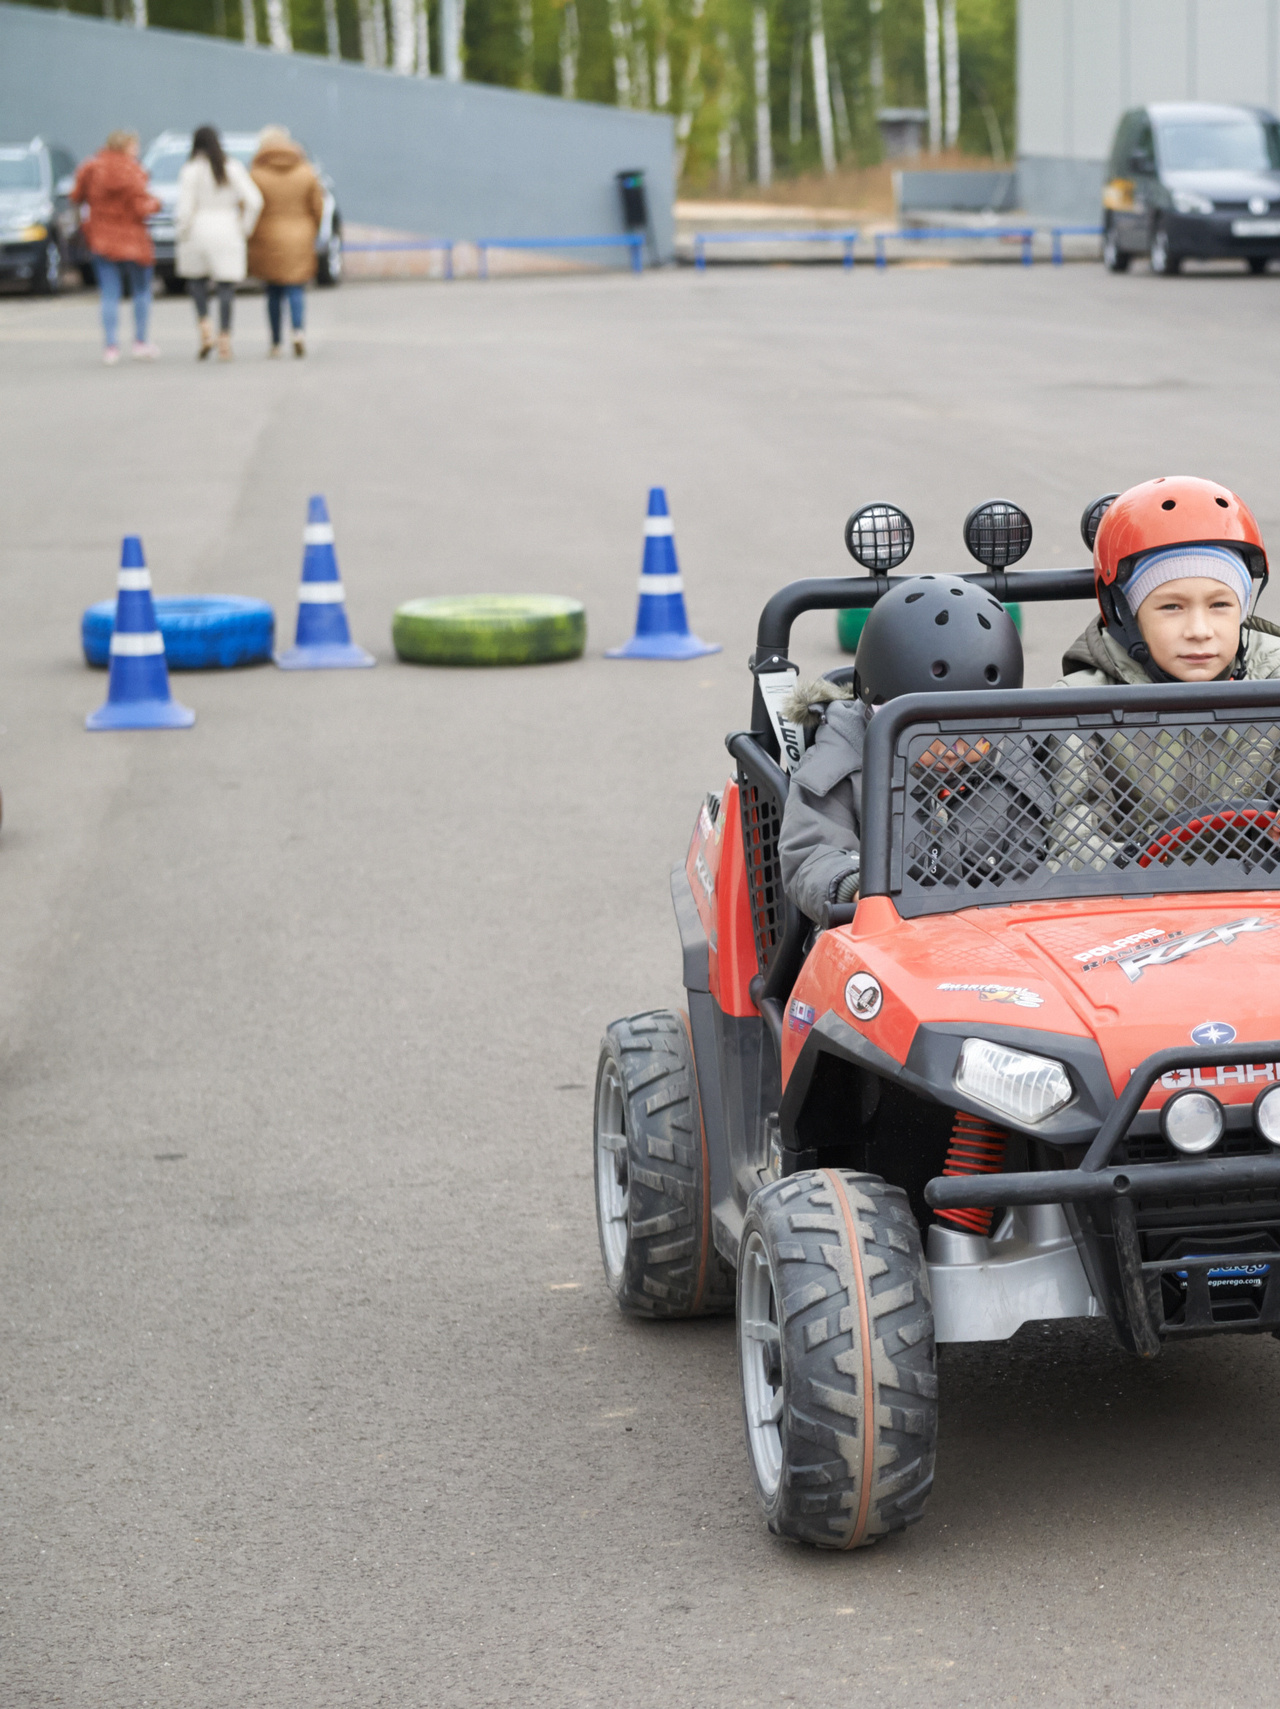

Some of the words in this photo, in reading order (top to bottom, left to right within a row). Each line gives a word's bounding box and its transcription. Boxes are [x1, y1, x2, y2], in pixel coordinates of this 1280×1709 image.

[1073, 927, 1166, 963] POLARIS
[1081, 929, 1186, 972] RANGER
[1116, 916, 1279, 983] RZR
